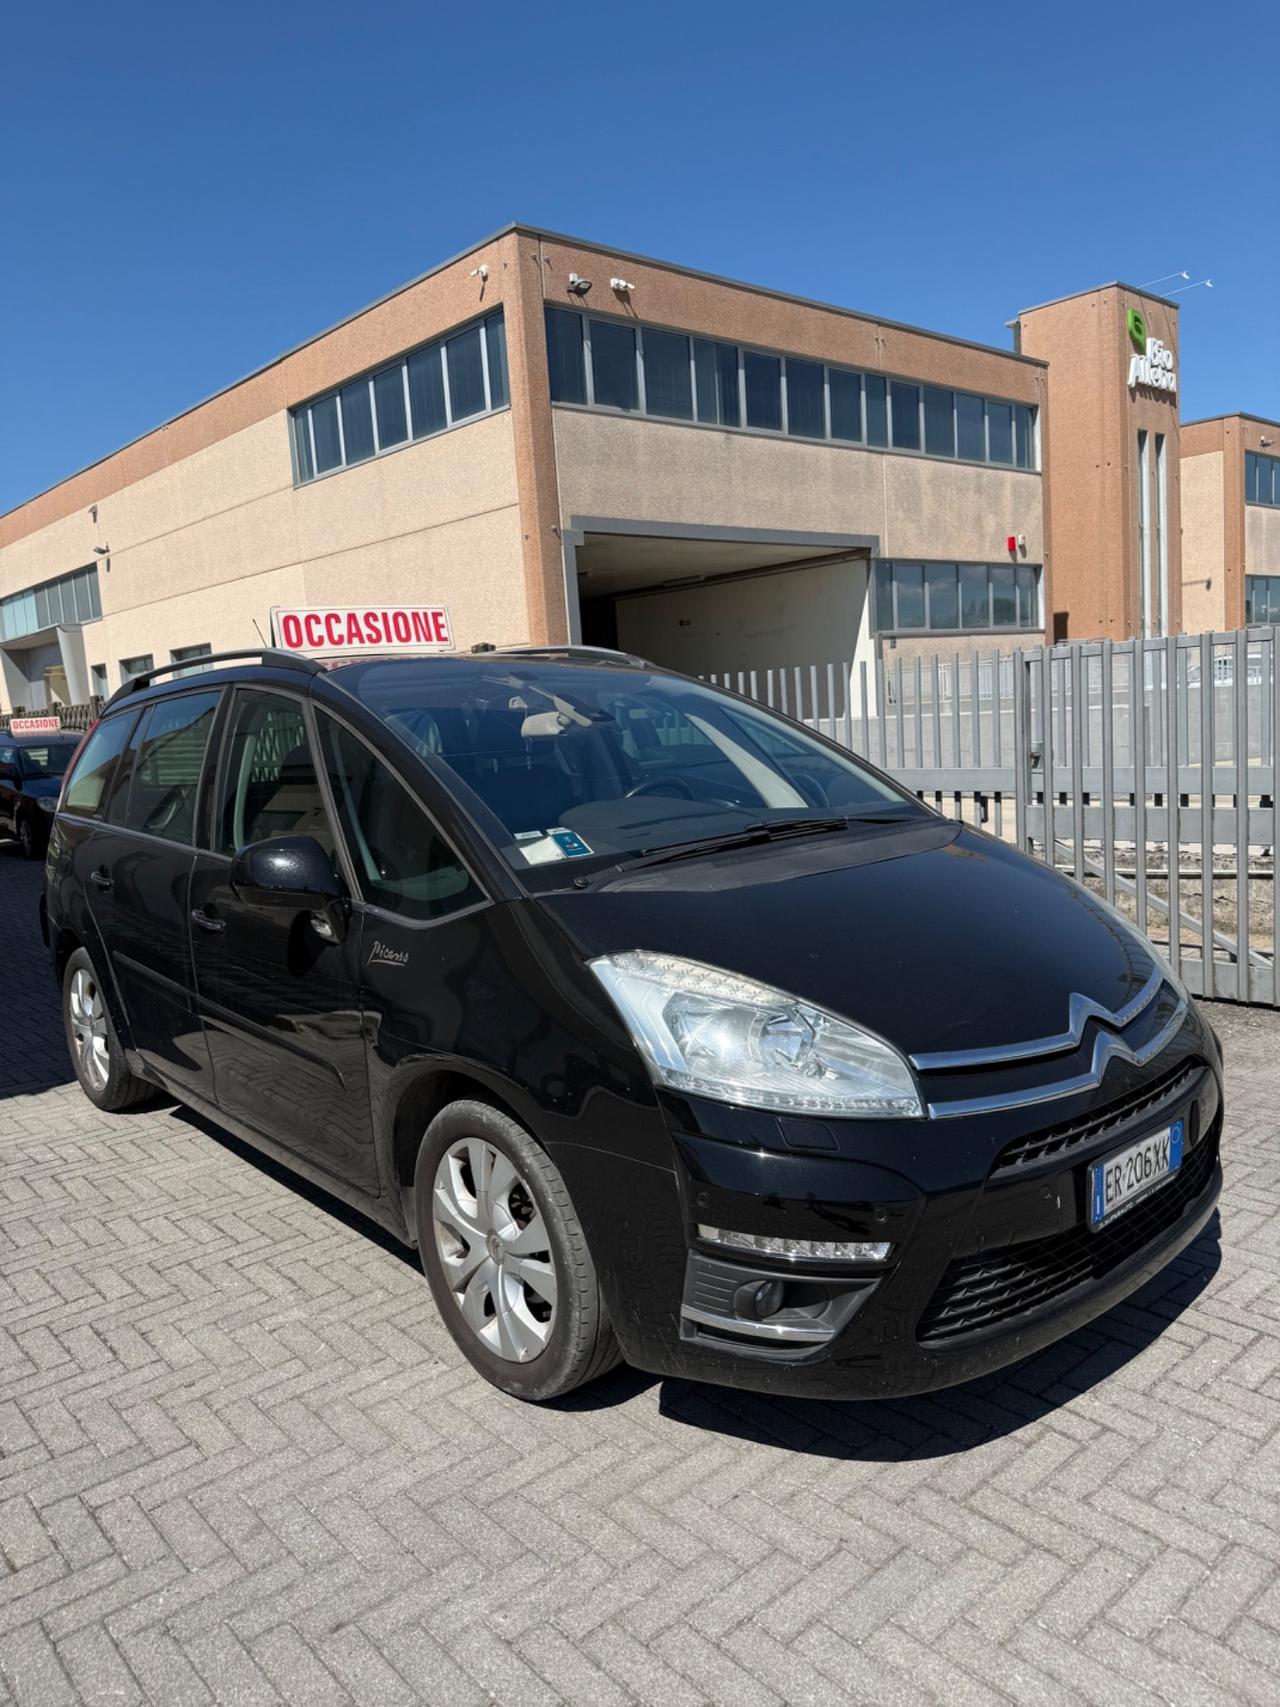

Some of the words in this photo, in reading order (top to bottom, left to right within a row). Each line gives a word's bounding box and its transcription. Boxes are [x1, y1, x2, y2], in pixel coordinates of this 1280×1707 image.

[282, 611, 449, 648] OCCASIONE
[13, 718, 59, 730] OCCASIONE
[1105, 1164, 1122, 1205] ER
[1126, 1136, 1170, 1191] 206XK
